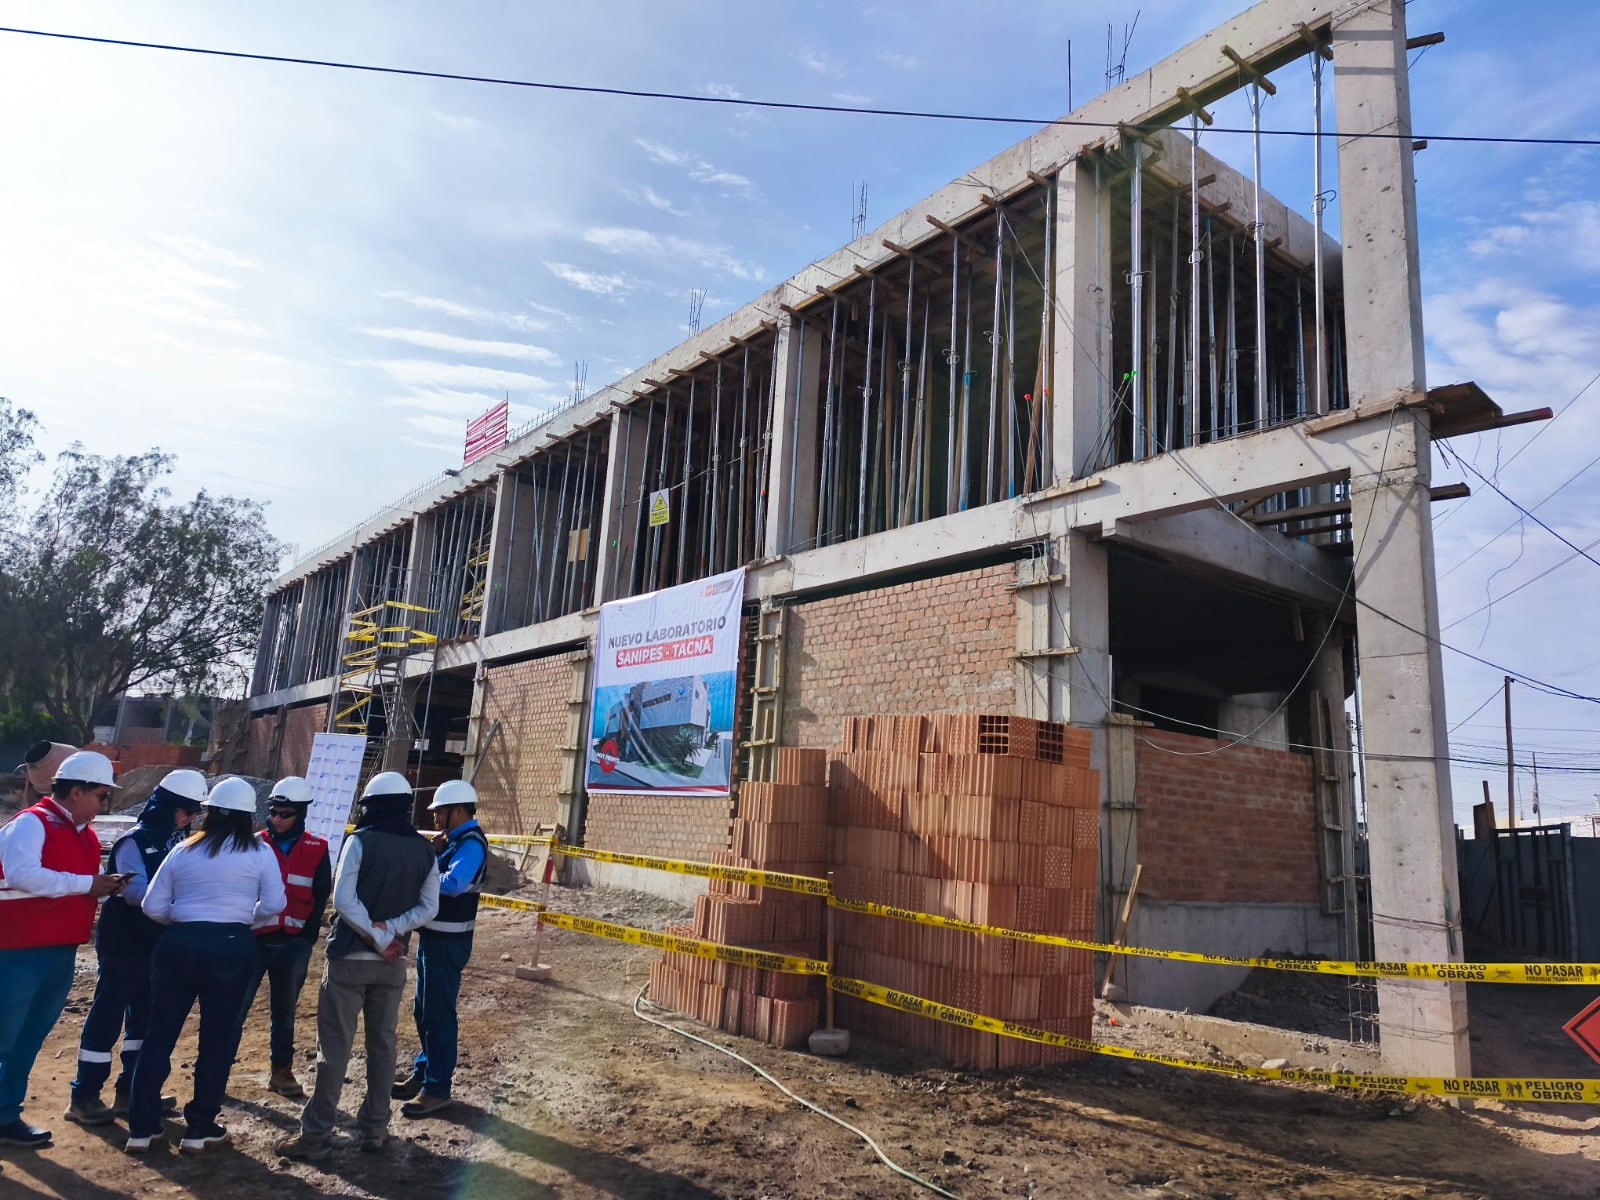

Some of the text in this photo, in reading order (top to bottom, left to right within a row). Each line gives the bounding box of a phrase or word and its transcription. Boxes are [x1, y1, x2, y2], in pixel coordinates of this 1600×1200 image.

[608, 615, 727, 649] NUEVO LABORATORIO
[617, 646, 663, 666] SANIPES
[672, 638, 712, 658] TACNA
[645, 862, 667, 870] OBRAS
[722, 873, 745, 882] OBRAS
[765, 873, 794, 883] NO PASAR
[886, 909, 917, 921] OBRAS
[580, 919, 595, 929] PASAR
[602, 924, 626, 934] PELIGRO
[604, 931, 624, 940] OBRAS
[648, 933, 664, 943] PASAR
[1001, 929, 1036, 940] OBRAS
[674, 939, 700, 948] PELIGRO
[676, 945, 698, 955] OBRAS
[716, 946, 724, 955] NO
[725, 947, 743, 959] PASAR
[1130, 949, 1169, 958] OBRAS
[755, 953, 785, 964] PELIGRO
[757, 960, 782, 970] OBRAS
[805, 961, 815, 971] NO
[1275, 963, 1319, 971] OBRAS
[1355, 962, 1408, 971] NO PASAR
[1525, 964, 1584, 977] NO PASAR
[1437, 970, 1485, 980] OBRAS
[832, 982, 861, 996] OBRAS
[886, 991, 898, 1001] NO
[900, 994, 924, 1008] PASAR
[940, 1006, 979, 1020] PELIGRO
[941, 1012, 974, 1026] OBRAS
[1003, 1022, 1016, 1032] NO
[1017, 1026, 1045, 1040] PASAR
[1063, 1036, 1105, 1049] PELIGRO
[1133, 1050, 1179, 1064] NO PASAR
[1280, 1070, 1331, 1083] NO PASAR
[1354, 1075, 1408, 1086] PELIGRO
[1359, 1083, 1406, 1091] OBRAS
[1443, 1079, 1500, 1092] NO PASAR
[1525, 1081, 1585, 1091] PELIGRO
[1531, 1090, 1583, 1101] OBRAS
